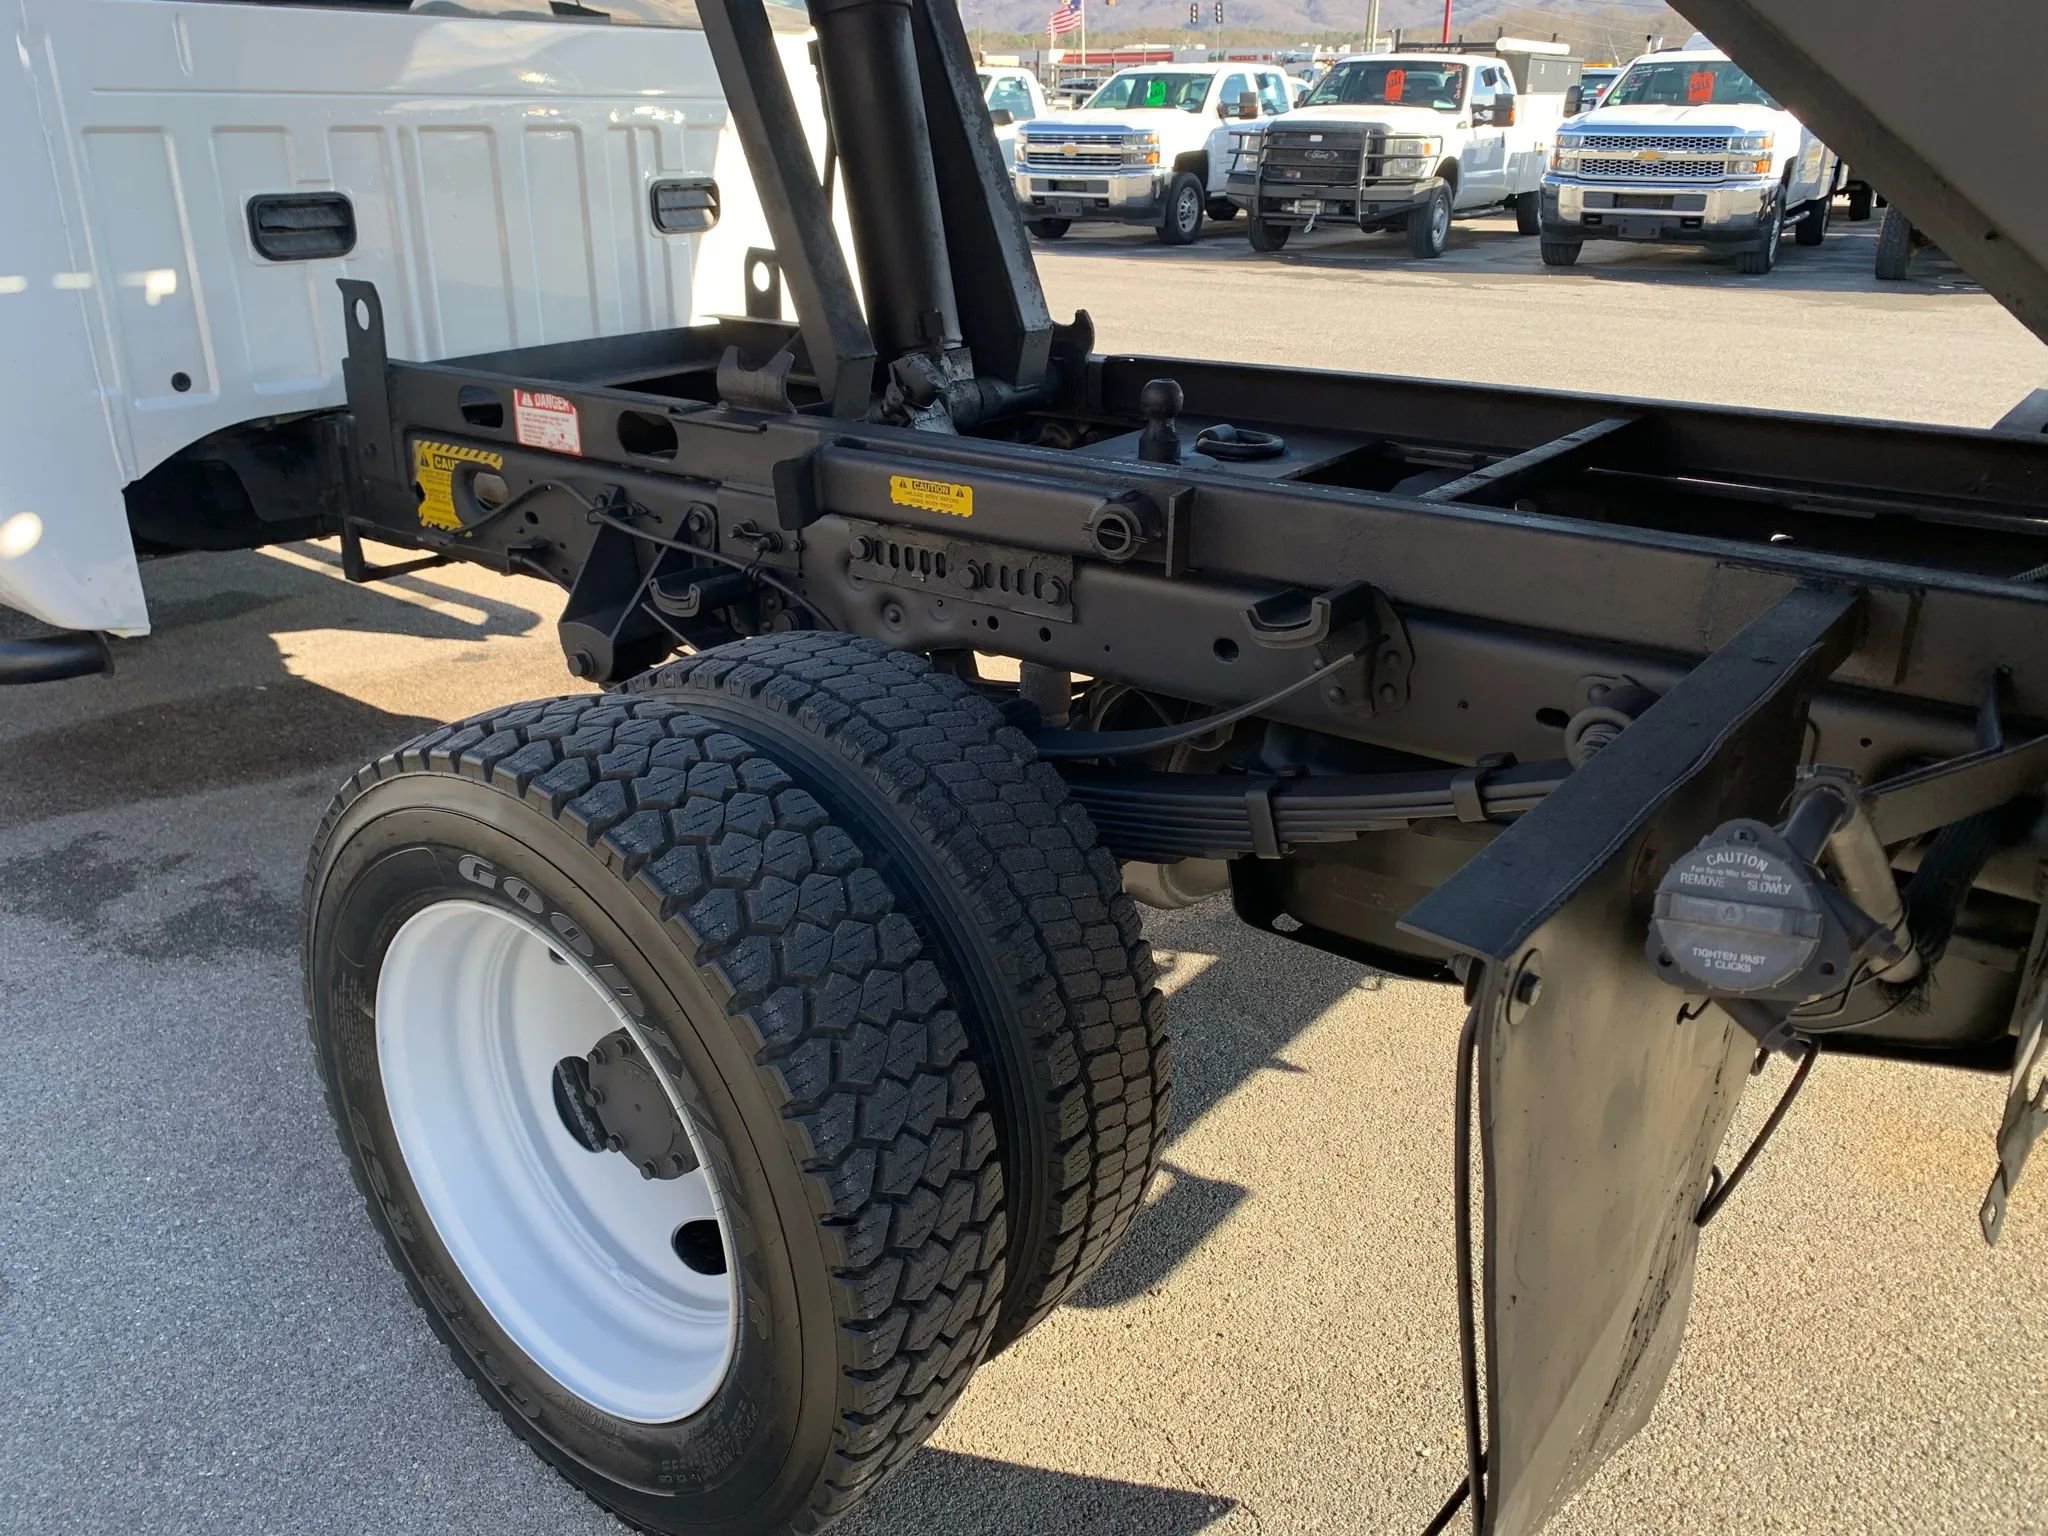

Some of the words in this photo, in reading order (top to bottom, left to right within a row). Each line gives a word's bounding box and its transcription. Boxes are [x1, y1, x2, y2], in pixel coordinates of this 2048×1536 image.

[1690, 79, 1711, 92] SALE
[534, 392, 569, 411] DANGER
[913, 482, 949, 494] CAUTION
[1706, 852, 1769, 872] CAUTION
[1706, 866, 1724, 876] Spray
[1726, 868, 1740, 878] May
[1679, 872, 1726, 889] REMOVE
[1747, 879, 1792, 896] SLOWLY
[1692, 947, 1739, 961] TIGHTEN
[1740, 953, 1766, 966] PAST
[1704, 959, 1711, 968] 3
[1715, 961, 1752, 973] CLICKS
[458, 854, 770, 1341] GOODYEAR
